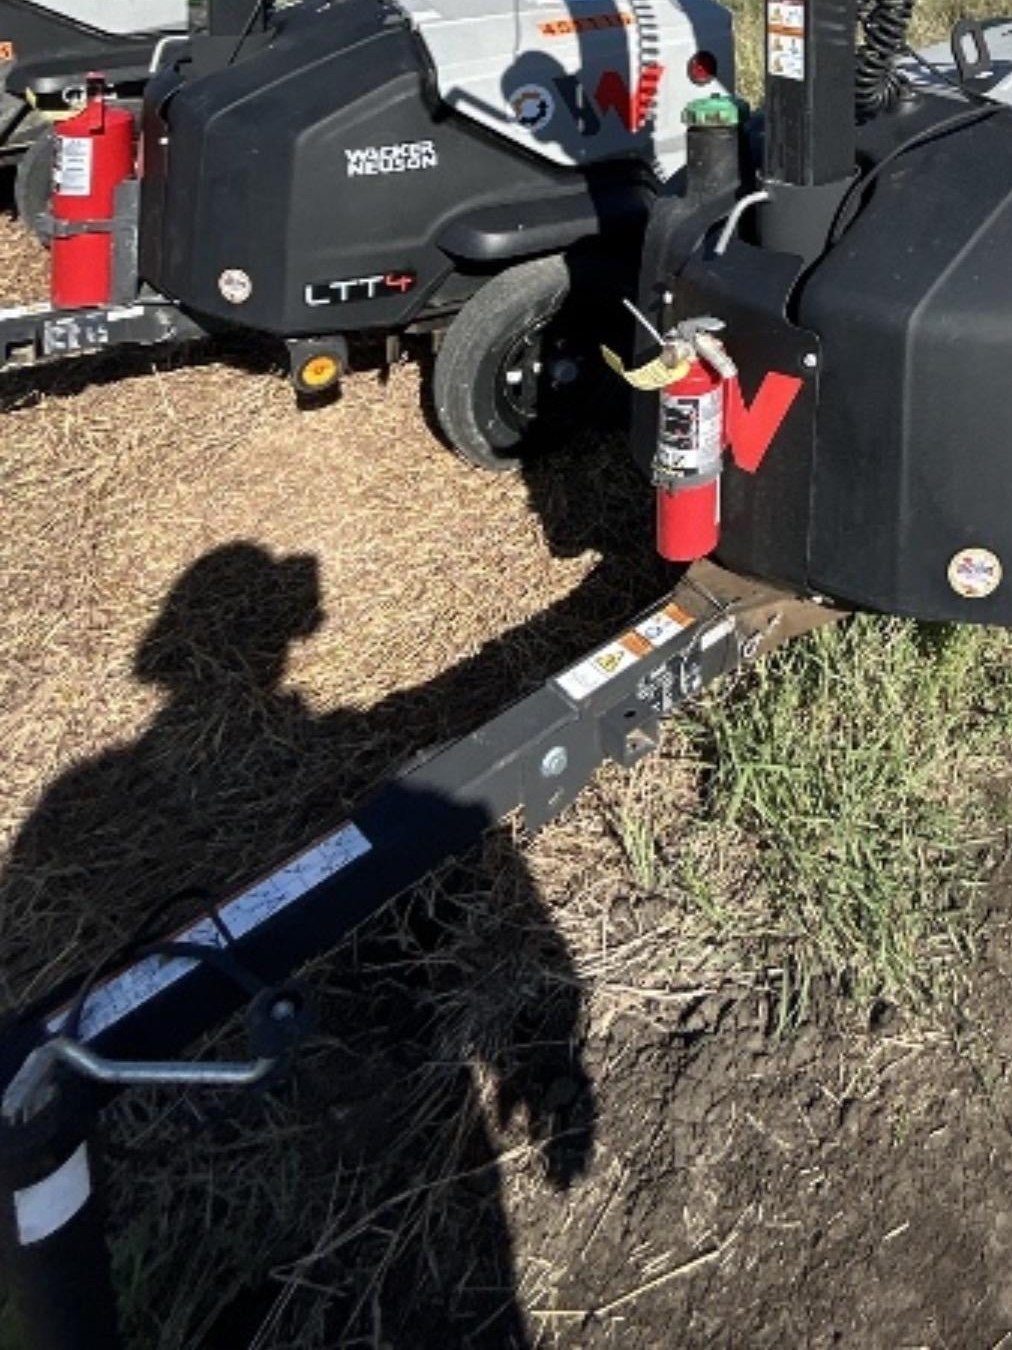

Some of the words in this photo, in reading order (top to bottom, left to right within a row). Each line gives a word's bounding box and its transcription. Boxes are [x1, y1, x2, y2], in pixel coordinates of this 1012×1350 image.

[343, 140, 436, 161] WACKER
[347, 154, 438, 178] NEUSON
[304, 274, 413, 307] LTT4
